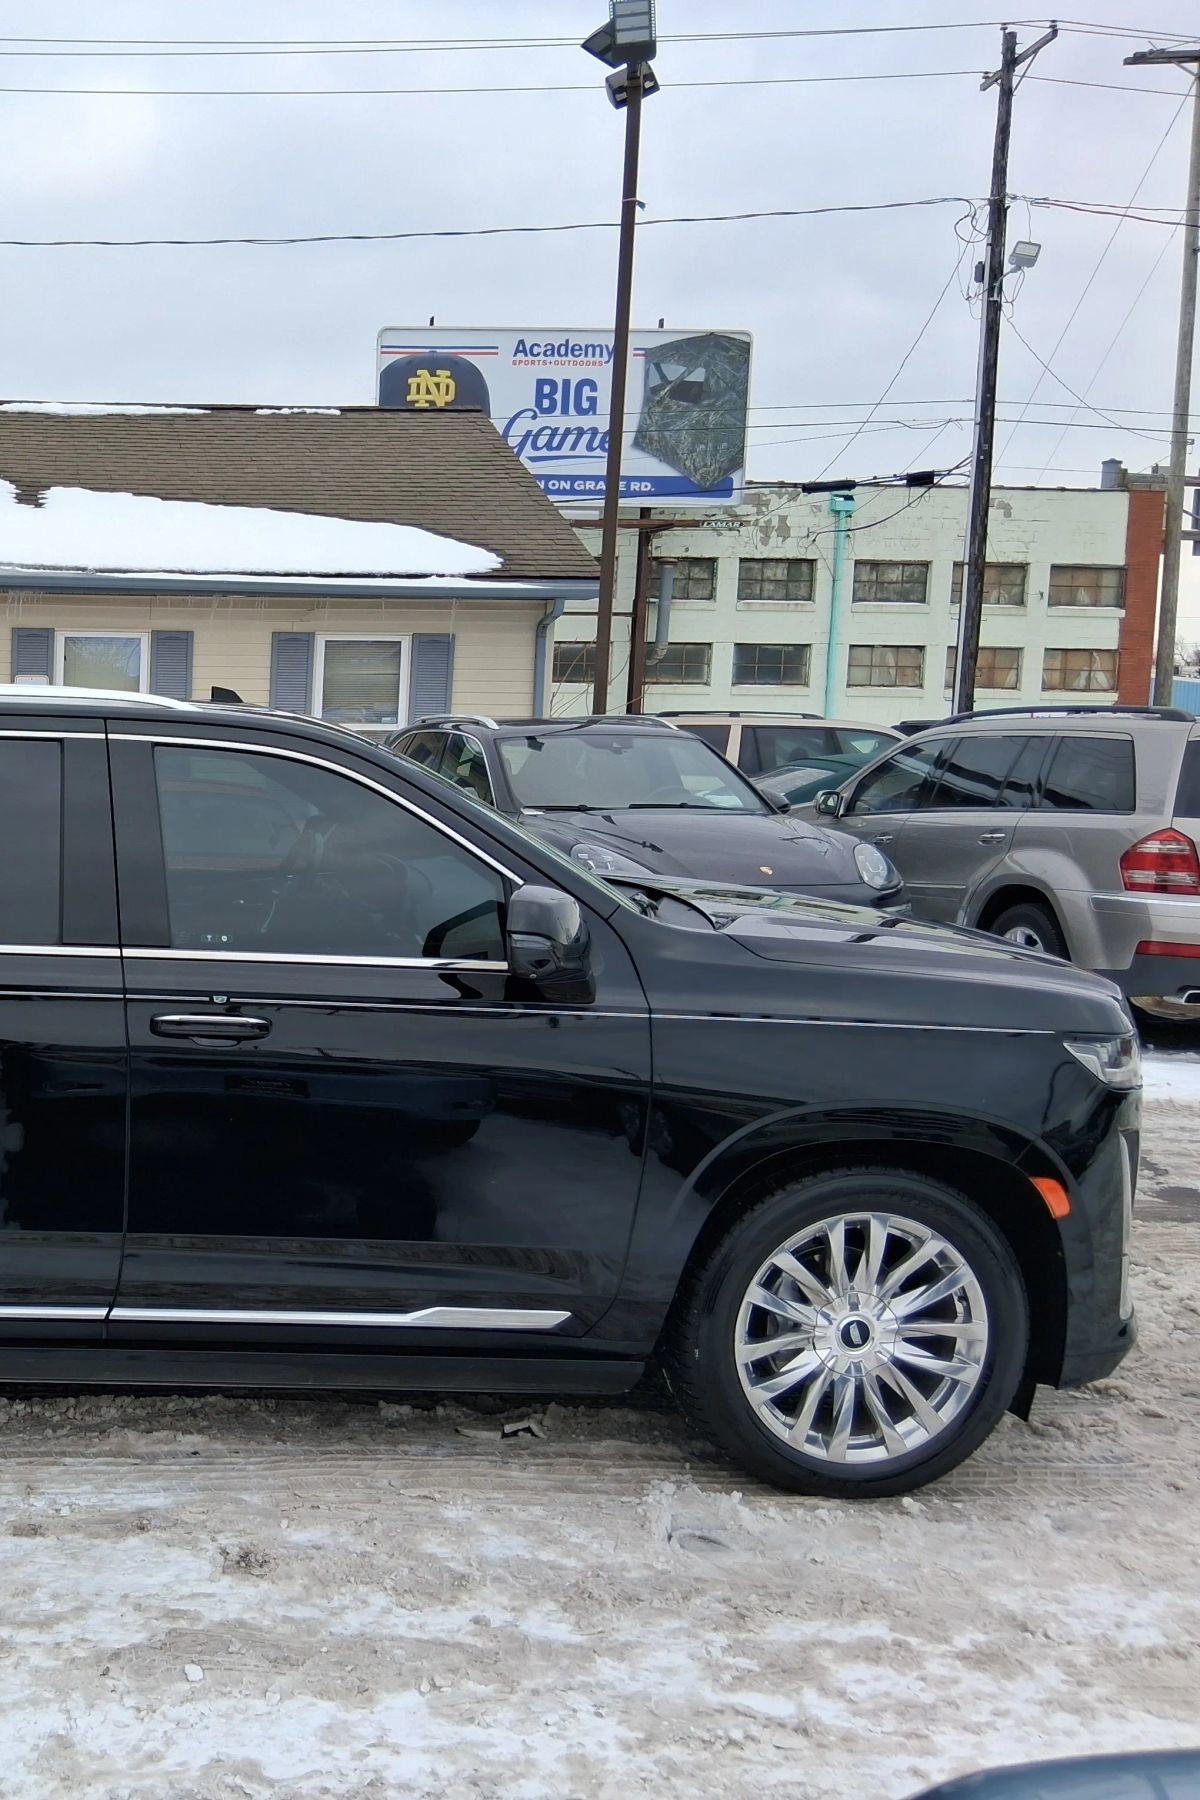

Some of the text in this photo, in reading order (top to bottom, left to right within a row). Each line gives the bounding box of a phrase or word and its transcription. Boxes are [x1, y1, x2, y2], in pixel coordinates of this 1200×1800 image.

[512, 338, 615, 364] Academy
[534, 378, 598, 416] BIG
[548, 479, 570, 490] ON
[574, 480, 627, 491] GRAE
[630, 481, 656, 492] RD.
